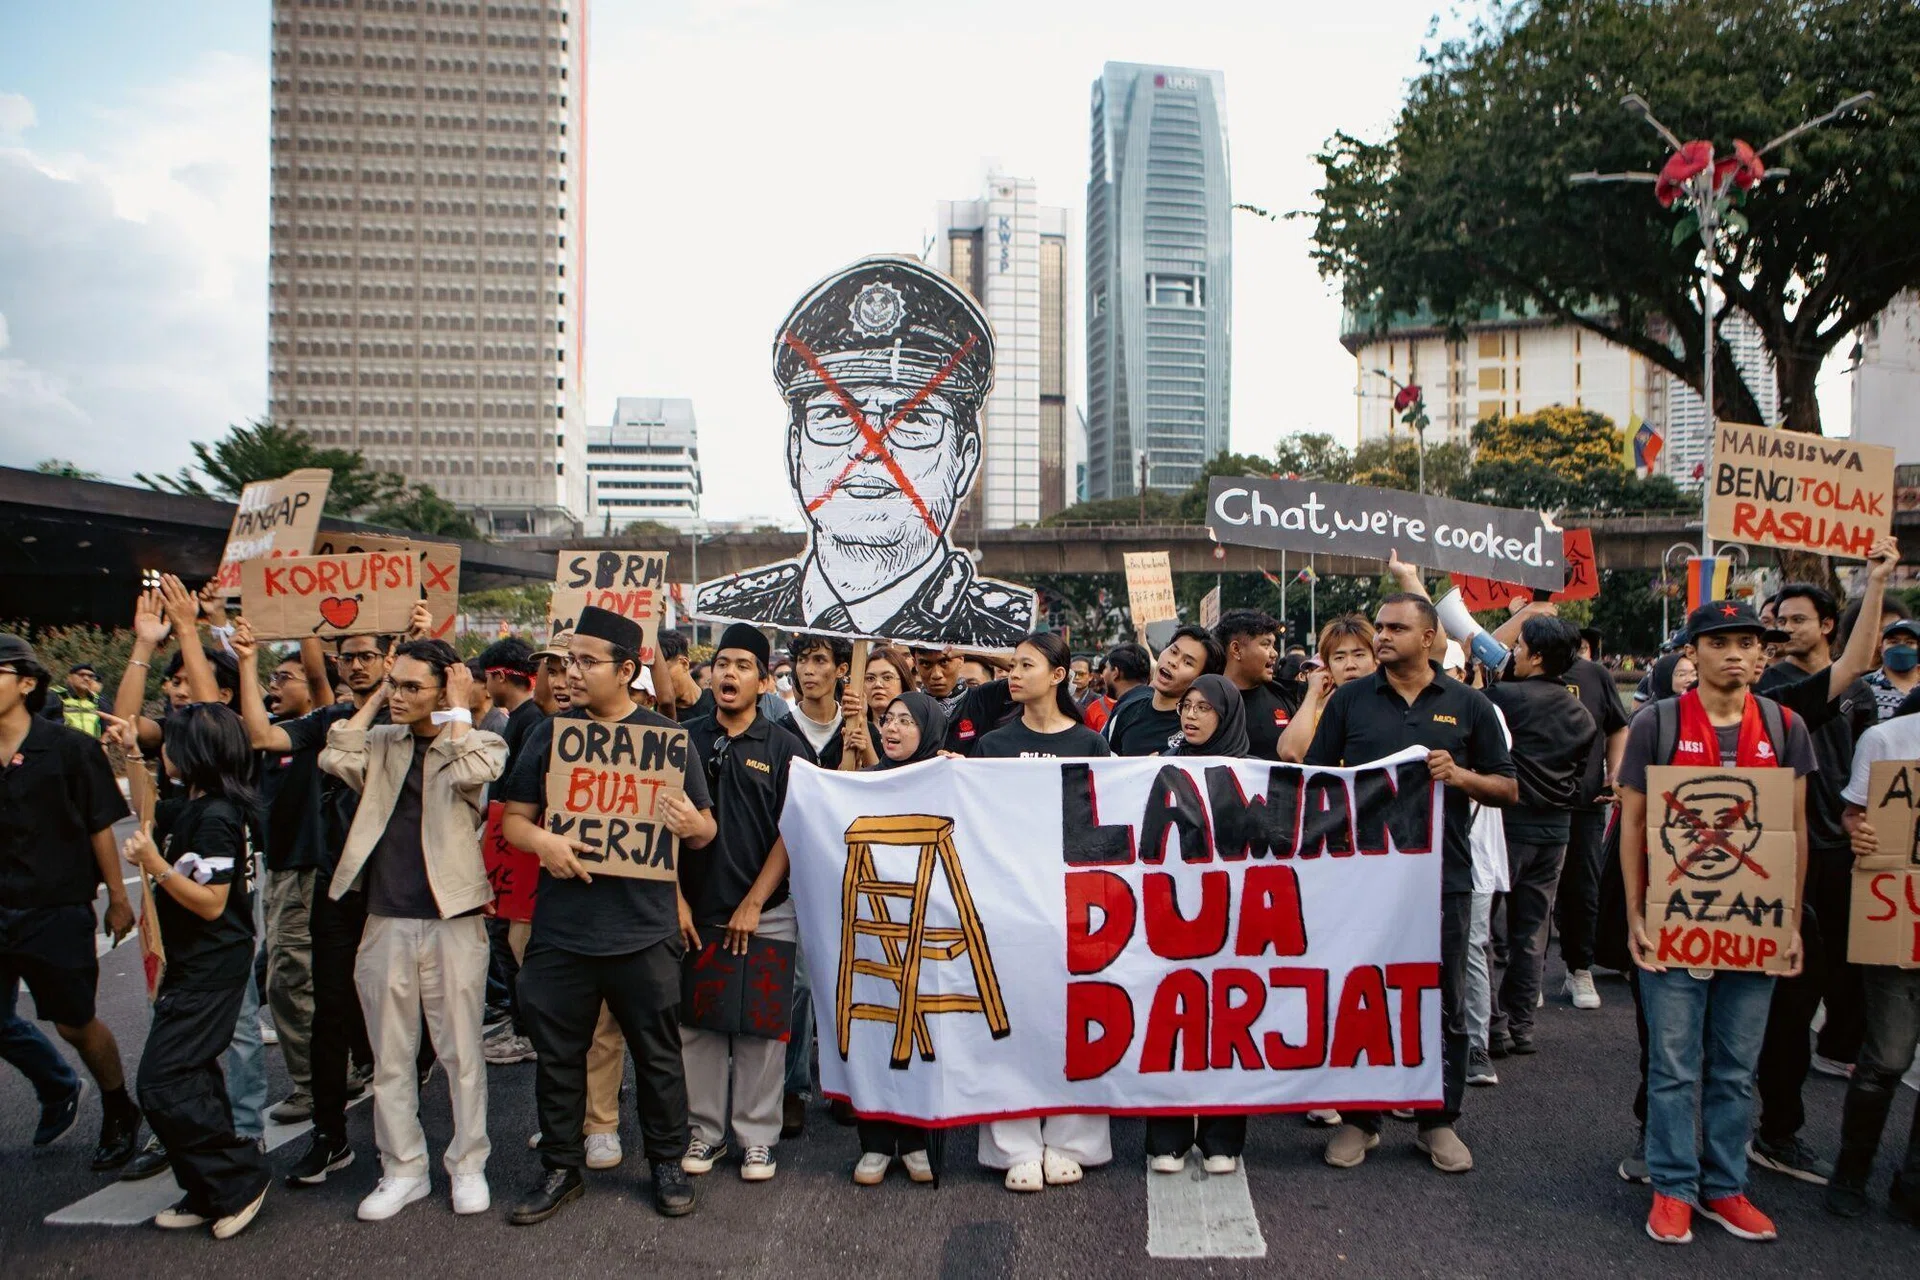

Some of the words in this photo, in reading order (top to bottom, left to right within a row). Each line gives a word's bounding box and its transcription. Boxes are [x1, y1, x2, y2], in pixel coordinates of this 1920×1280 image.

[999, 216, 1011, 275] KWSP
[1722, 429, 1863, 472] MAHASISWA
[1716, 463, 1794, 503] BENCI
[1799, 477, 1884, 517] TOLAK
[1214, 487, 1337, 539] Chat,
[1334, 510, 1426, 543] we're
[1434, 522, 1554, 567] cooked.
[1733, 502, 1875, 556] RASUAH
[264, 553, 413, 597] KORUPSI
[569, 551, 664, 590] SPRM
[1433, 713, 1457, 726] MUDA
[558, 722, 686, 773] ORANG
[746, 758, 770, 774] MUDA
[565, 767, 667, 818] BUAT
[1061, 760, 1435, 867] LAWAN
[550, 813, 675, 871] KERJA
[1065, 864, 1308, 976] DUA
[1664, 888, 1784, 929] AZAM
[1657, 924, 1778, 968] KORUP
[1064, 962, 1442, 1082] DARJAT
